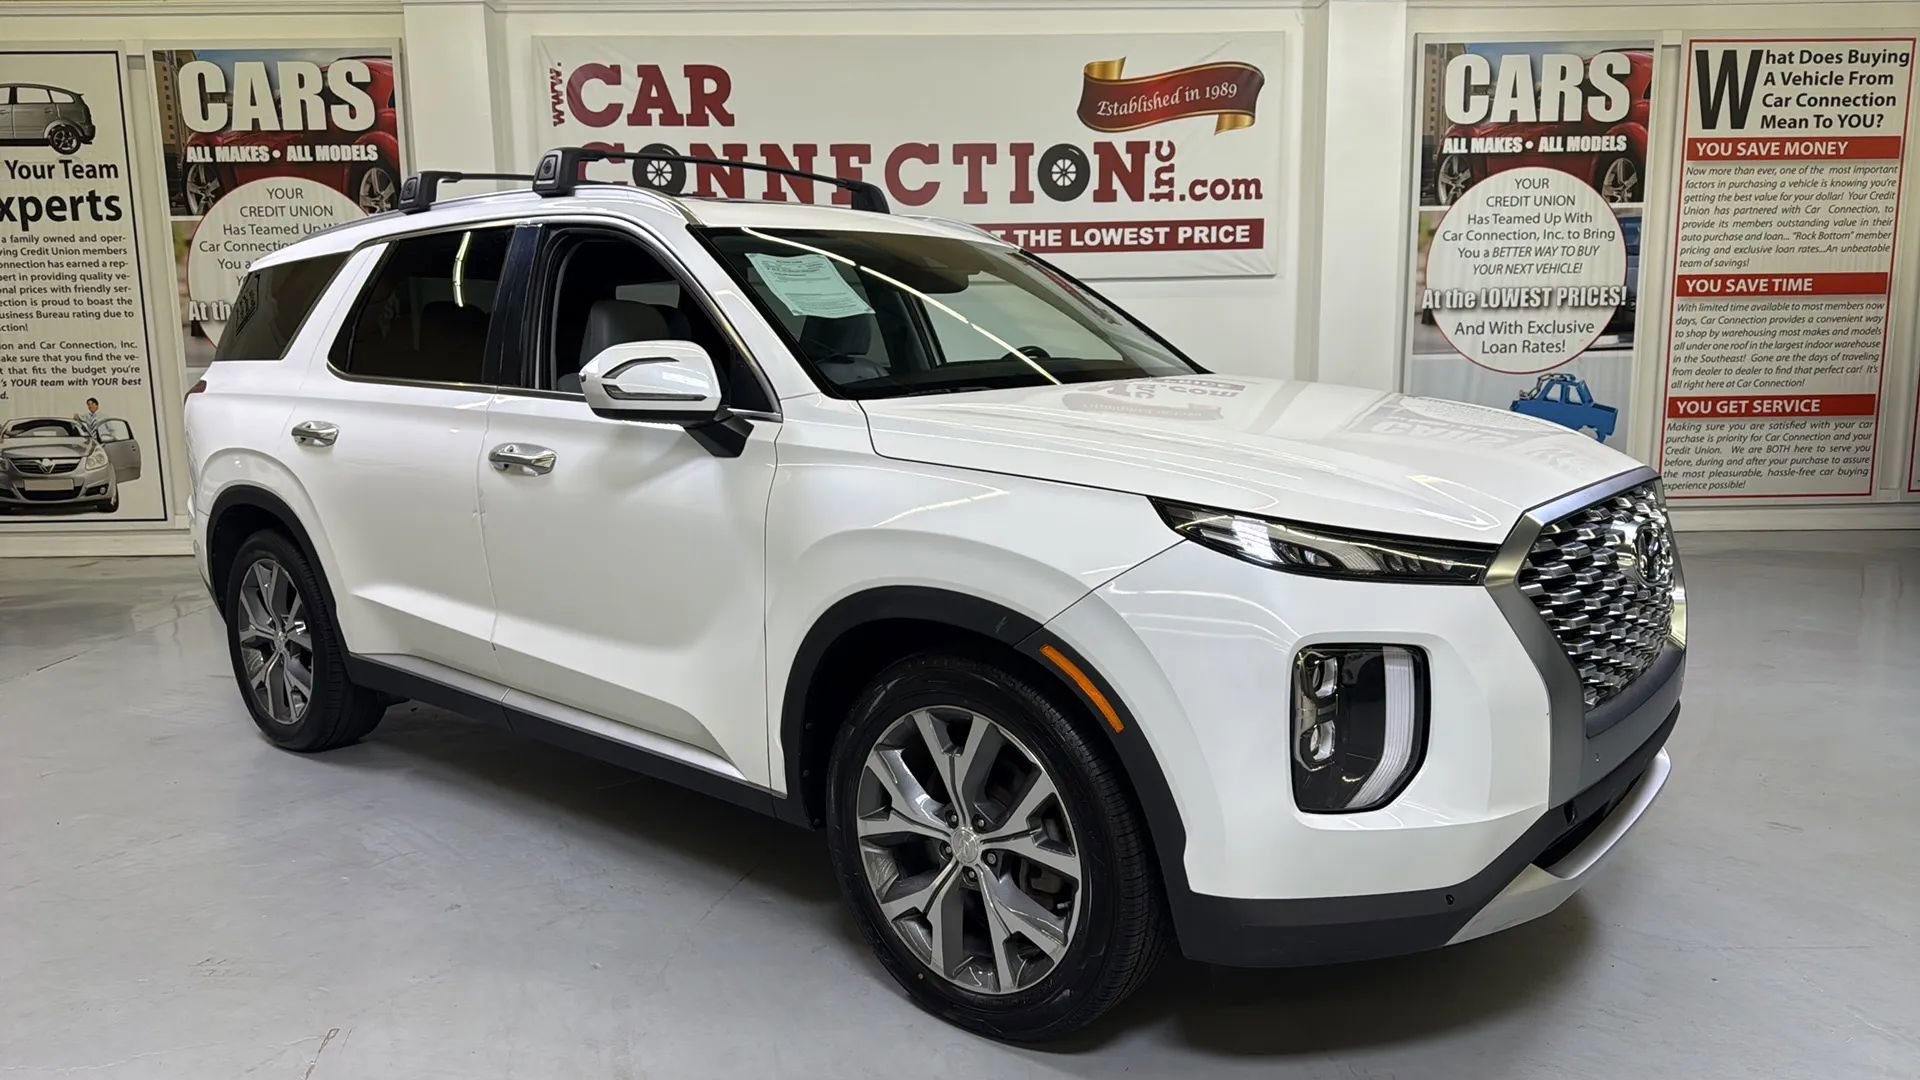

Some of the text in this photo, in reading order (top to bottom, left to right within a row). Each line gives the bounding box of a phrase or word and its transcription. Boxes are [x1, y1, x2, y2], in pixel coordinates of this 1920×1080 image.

[1800, 50, 1843, 64] Does
[1848, 49, 1910, 67] Buying
[1764, 71, 1893, 86] A Vehicle From
[567, 62, 736, 128] CAR
[1445, 53, 1631, 124] CARS
[178, 60, 376, 132] CARS
[1097, 82, 1237, 116] Established in 1989
[1762, 92, 1896, 107] Car Connection
[1761, 114, 1884, 128] Mean To YOU?
[1442, 135, 1627, 154] ALL MAKES ALL MODELS
[1696, 142, 1848, 156] YOU SAVE MONEY
[186, 144, 378, 163] ALL MAKES ALL MODELS
[4, 160, 118, 179] Your Team
[1686, 167, 1707, 175] Now
[1734, 166, 1755, 175] than
[1757, 168, 1776, 176] ever,
[1798, 166, 1810, 174] of
[1810, 165, 1824, 174] the
[1829, 165, 1851, 174] most
[1853, 165, 1898, 176] important
[1515, 178, 1549, 189] YOUR
[266, 188, 304, 199] YOUR
[1486, 195, 1575, 207] CREDIT UNION
[240, 206, 333, 218] CREDIT UNION
[1468, 212, 1592, 226] Has Teamed Up With
[223, 224, 246, 235] Has
[248, 223, 299, 235] Teamed
[1442, 228, 1615, 242] Car Connection, Inc. to Bring
[10, 234, 39, 244] family
[43, 234, 75, 243] owned
[79, 234, 97, 242] and
[100, 236, 126, 244] oper-
[1013, 229, 1062, 247] THE
[1070, 227, 1169, 246] LOWEST
[1179, 225, 1249, 243] PRICE
[20, 248, 49, 256] Credit
[199, 241, 220, 252] Car
[1458, 245, 1600, 258] You a BETTER WAY TO BUY
[48, 260, 64, 268] has
[66, 260, 100, 268] earned
[110, 261, 128, 269] rep-
[218, 258, 251, 269] You a
[1474, 262, 1583, 275] YOUR NEXT VEHICLE!
[19, 273, 28, 281] in
[30, 272, 77, 282] providing
[80, 272, 112, 282] quality
[20, 286, 48, 295] prices
[50, 285, 71, 293] with
[74, 285, 111, 294] friendly
[1686, 278, 1812, 292] YOU SAVE TIME
[30, 298, 38, 306] is
[42, 298, 70, 307] proud
[73, 298, 84, 306] to
[1422, 286, 1627, 309] At the LOWEST PRICES!
[72, 310, 100, 320] rating
[103, 310, 122, 318] due
[189, 300, 232, 321] At th
[1454, 320, 1594, 335] And With Exclusive
[18, 341, 36, 350] and
[40, 341, 56, 350] Car
[60, 341, 116, 349] Connection,
[1482, 340, 1565, 354] Loan Rates!
[42, 354, 62, 362] that
[64, 355, 82, 363] you
[106, 353, 121, 361] the
[32, 366, 46, 374] fits
[51, 366, 67, 374] the
[72, 366, 106, 375] budget
[111, 366, 140, 375] you're
[10, 378, 37, 387] YOUR
[68, 378, 88, 386] with
[92, 378, 118, 386] YOUR
[122, 377, 141, 385] best
[1671, 378, 1806, 390] all right here at Car Connection!
[1677, 400, 1820, 414] YOU GET SERVICE
